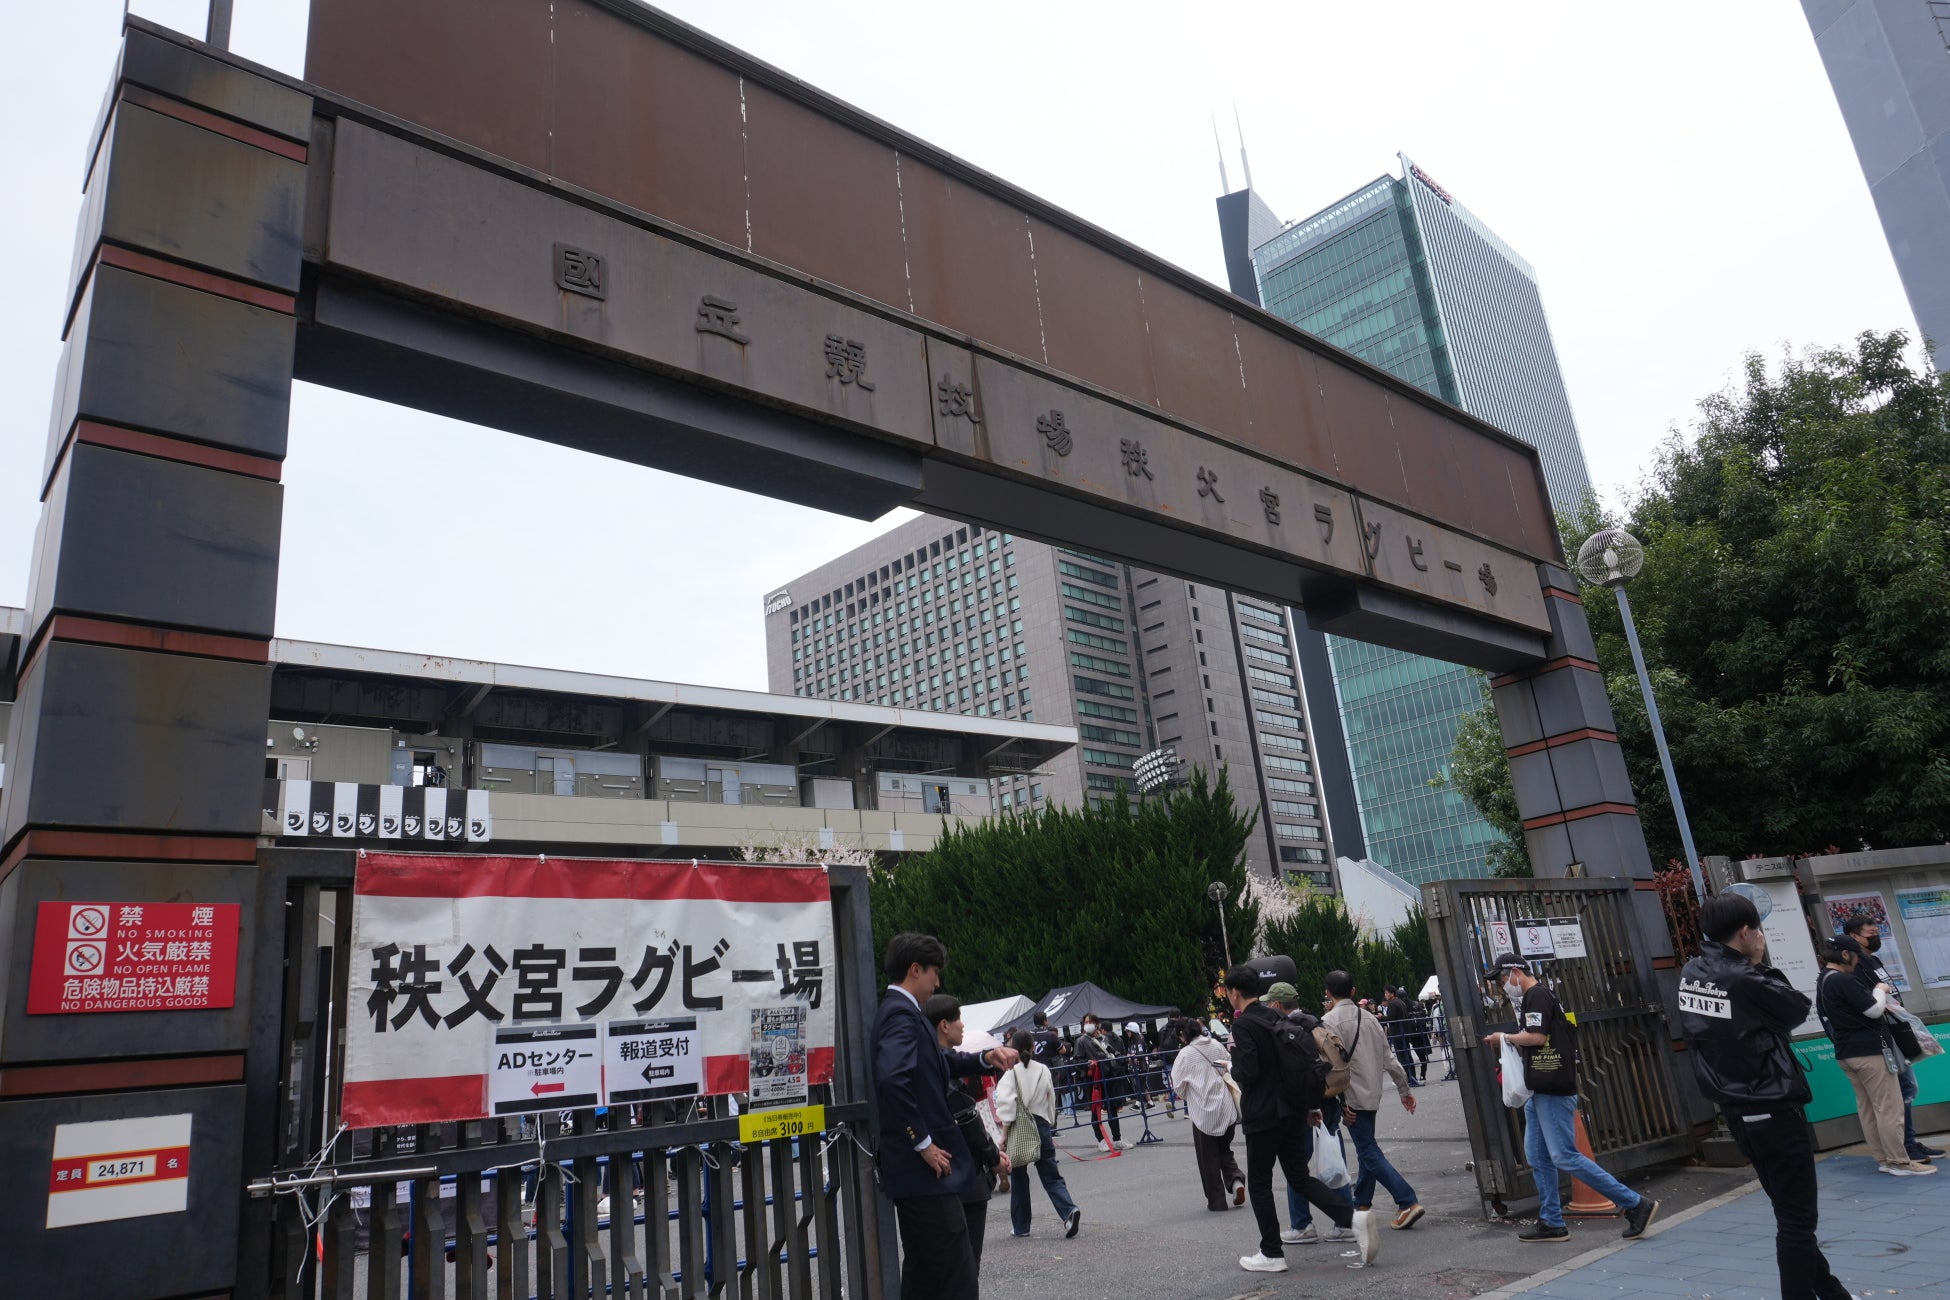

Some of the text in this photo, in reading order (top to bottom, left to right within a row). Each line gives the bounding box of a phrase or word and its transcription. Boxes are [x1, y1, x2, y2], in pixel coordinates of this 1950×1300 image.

[119, 905, 214, 926] 禁 煙
[117, 929, 214, 939] NO SMOKING
[115, 940, 212, 962] 火気厳禁
[113, 964, 211, 974] NO OPEN FLAME
[62, 975, 210, 1000] 危険物品持込厳禁
[367, 937, 823, 1033] 秩父宮ラグビー場
[61, 997, 208, 1010] NO DANGEROUS GOODS
[1679, 994, 1725, 1014] STAFF
[497, 1048, 593, 1070] ADセンター
[620, 1036, 690, 1062] 報道受付
[779, 1121, 803, 1137] 3100
[56, 1158, 178, 1181] 定員 24,871 名
